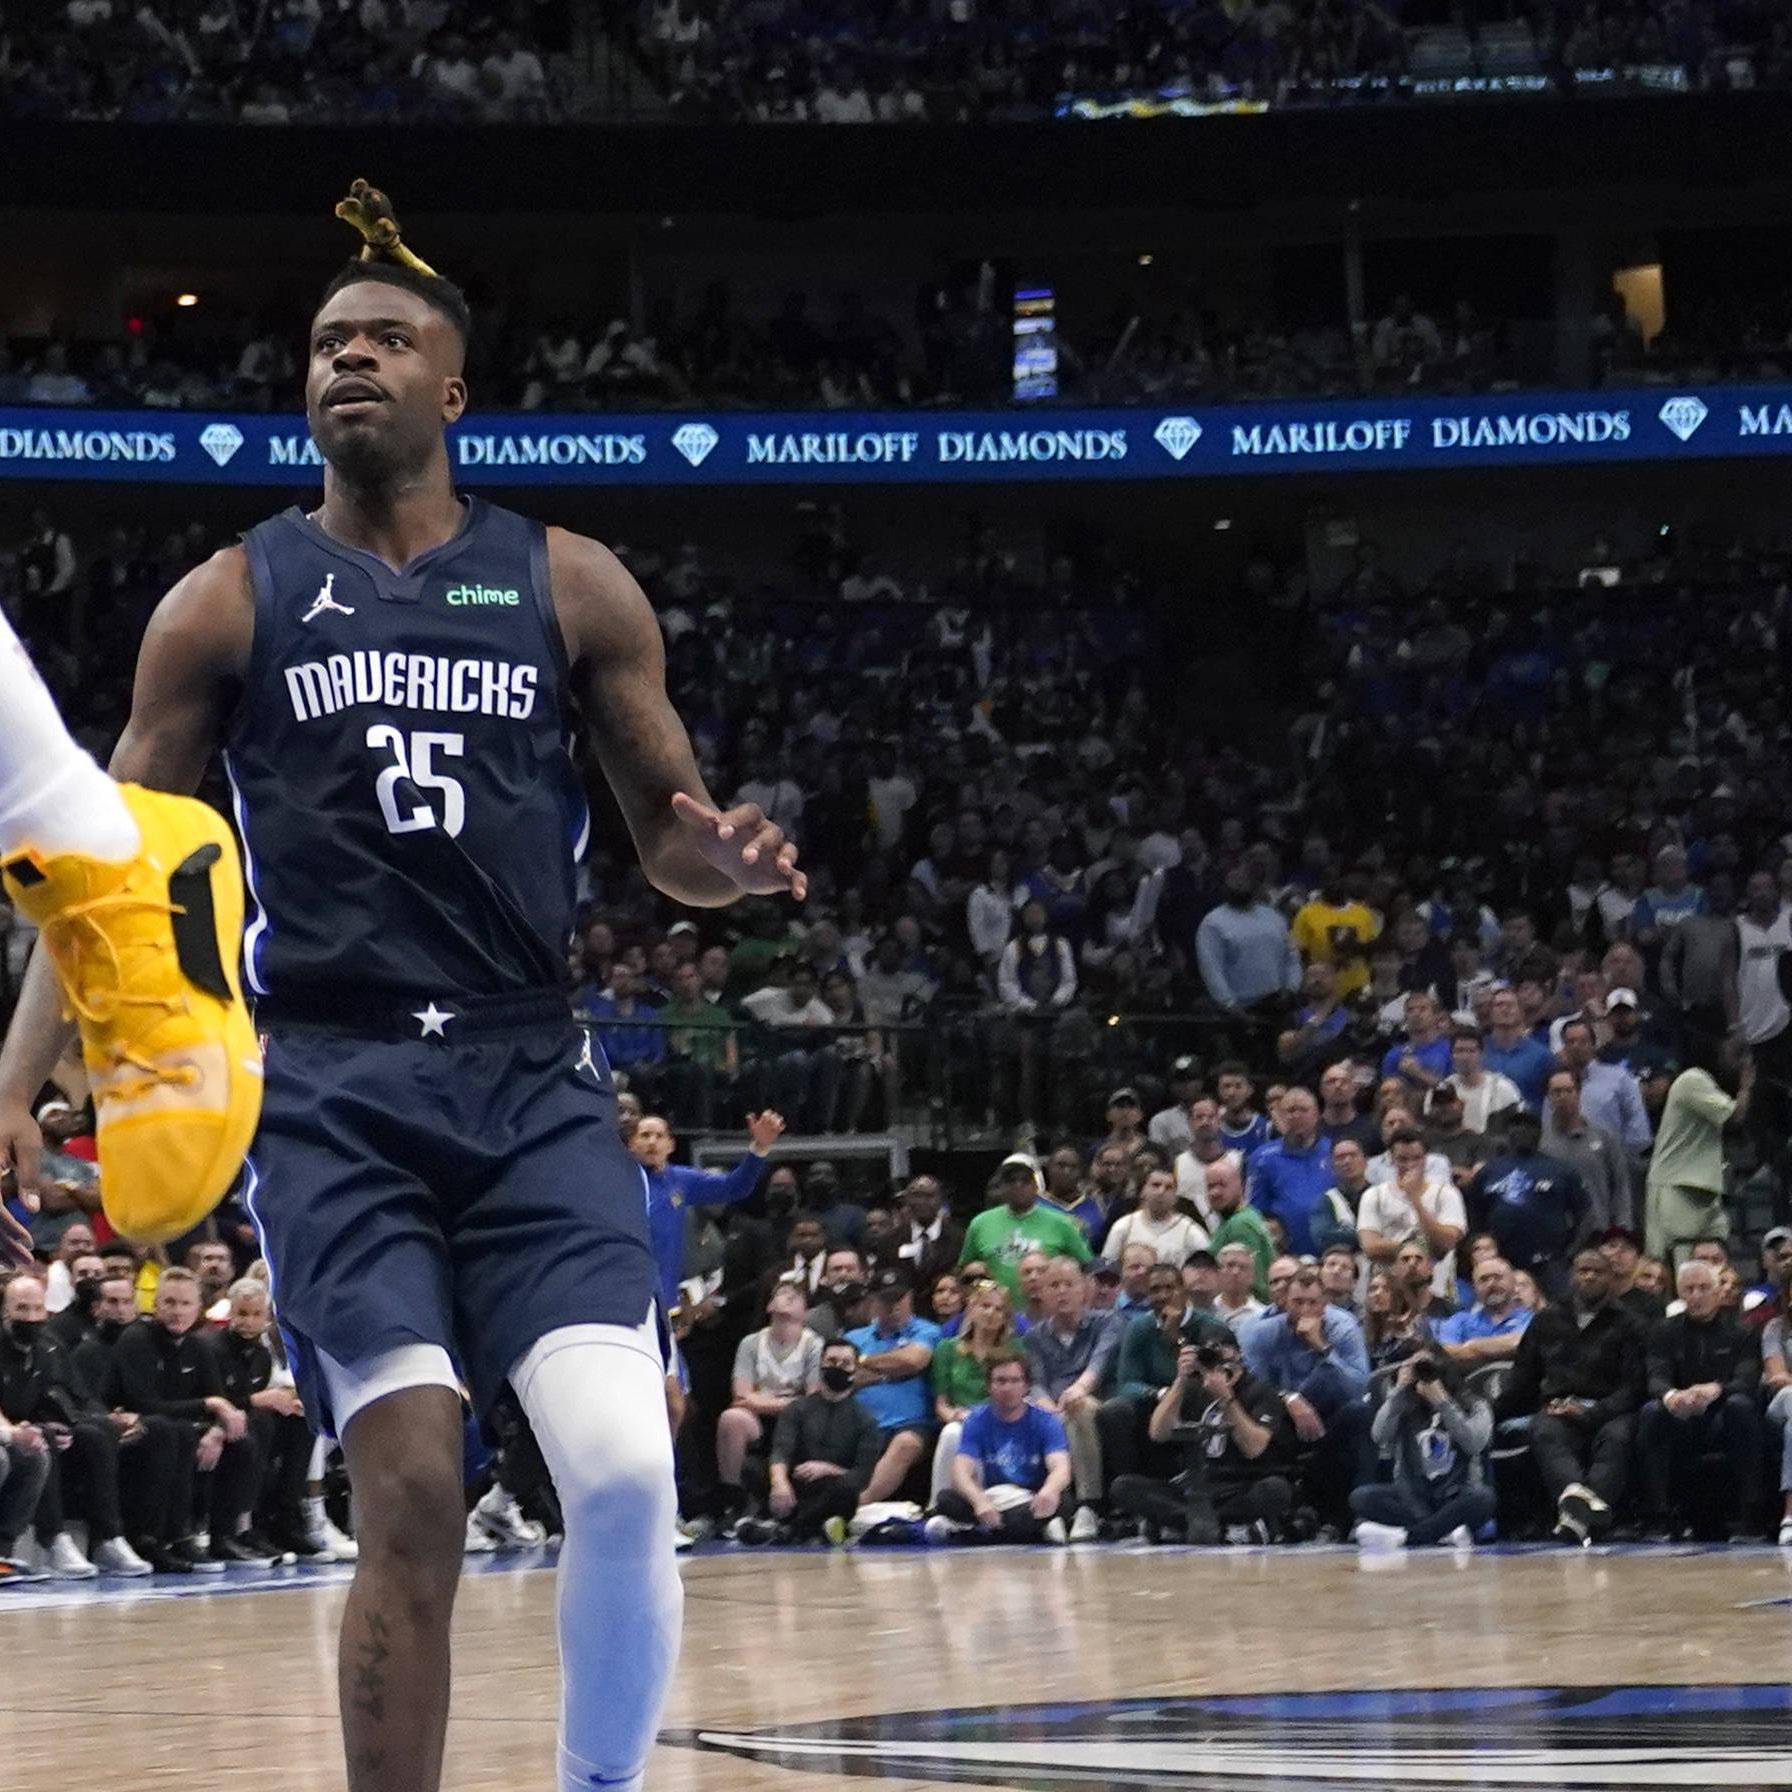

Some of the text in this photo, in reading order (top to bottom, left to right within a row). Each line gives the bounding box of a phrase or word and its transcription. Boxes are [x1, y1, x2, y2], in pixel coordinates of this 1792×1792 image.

[458, 434, 647, 465] DIAMONDS
[746, 429, 1128, 464] MARILOFF DIAMONDS
[1231, 409, 1631, 456] MARILOFF DIAMONDS
[446, 583, 520, 606] chime
[284, 650, 538, 722] MAVERICKS
[366, 724, 465, 839] 25
